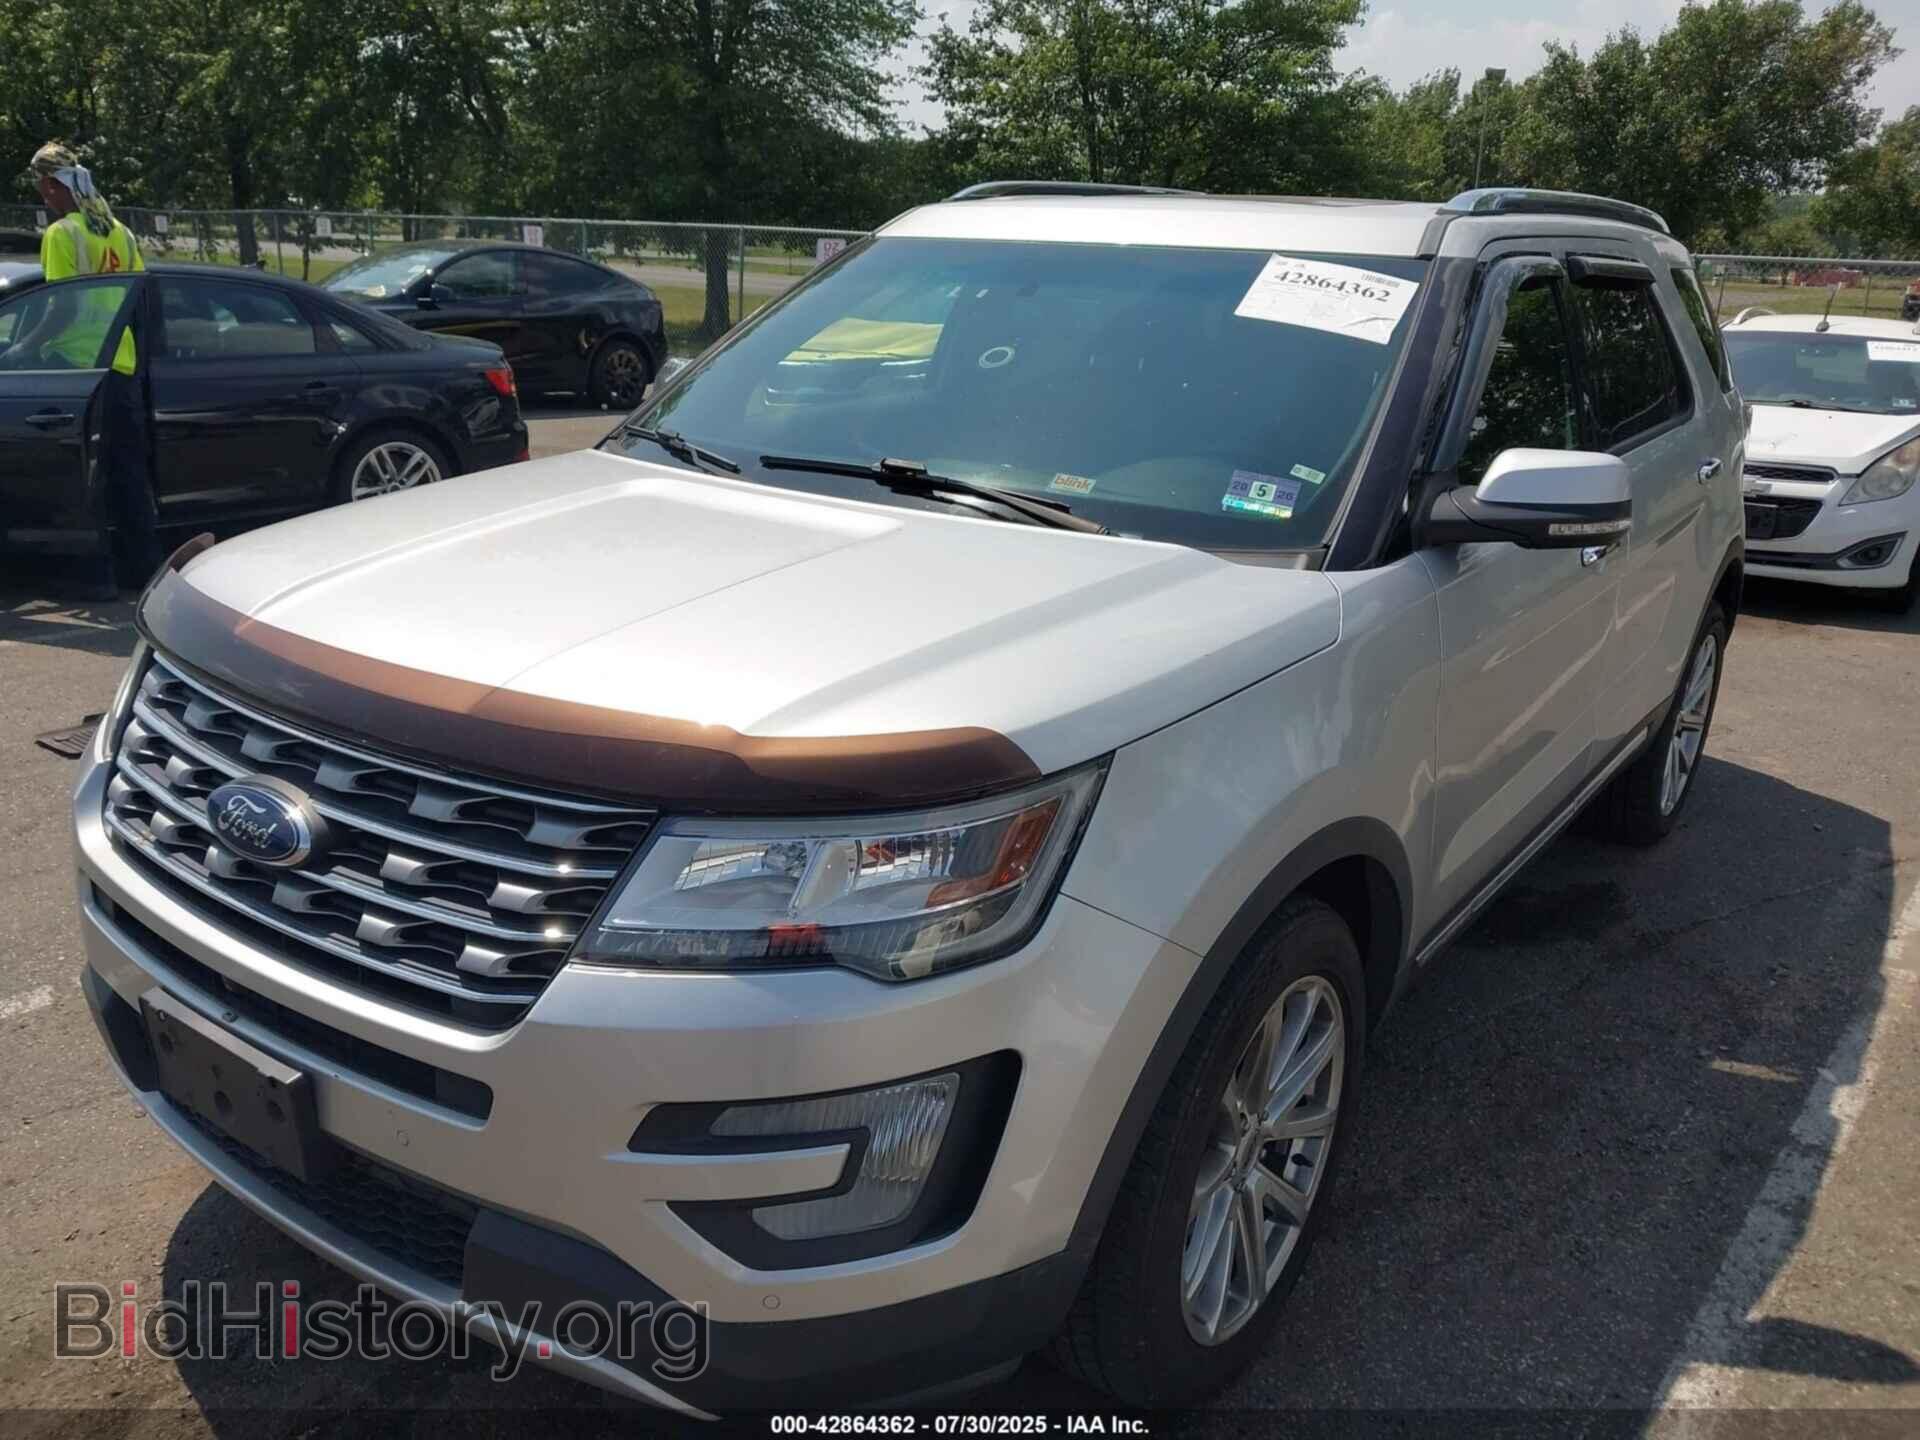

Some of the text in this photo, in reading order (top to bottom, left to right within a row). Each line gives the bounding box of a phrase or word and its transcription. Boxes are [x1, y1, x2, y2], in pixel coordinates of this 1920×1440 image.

[1273, 271, 1390, 302] 42864362
[1055, 474, 1091, 491] blink
[1256, 485, 1268, 497] 5
[218, 795, 278, 848] Ford
